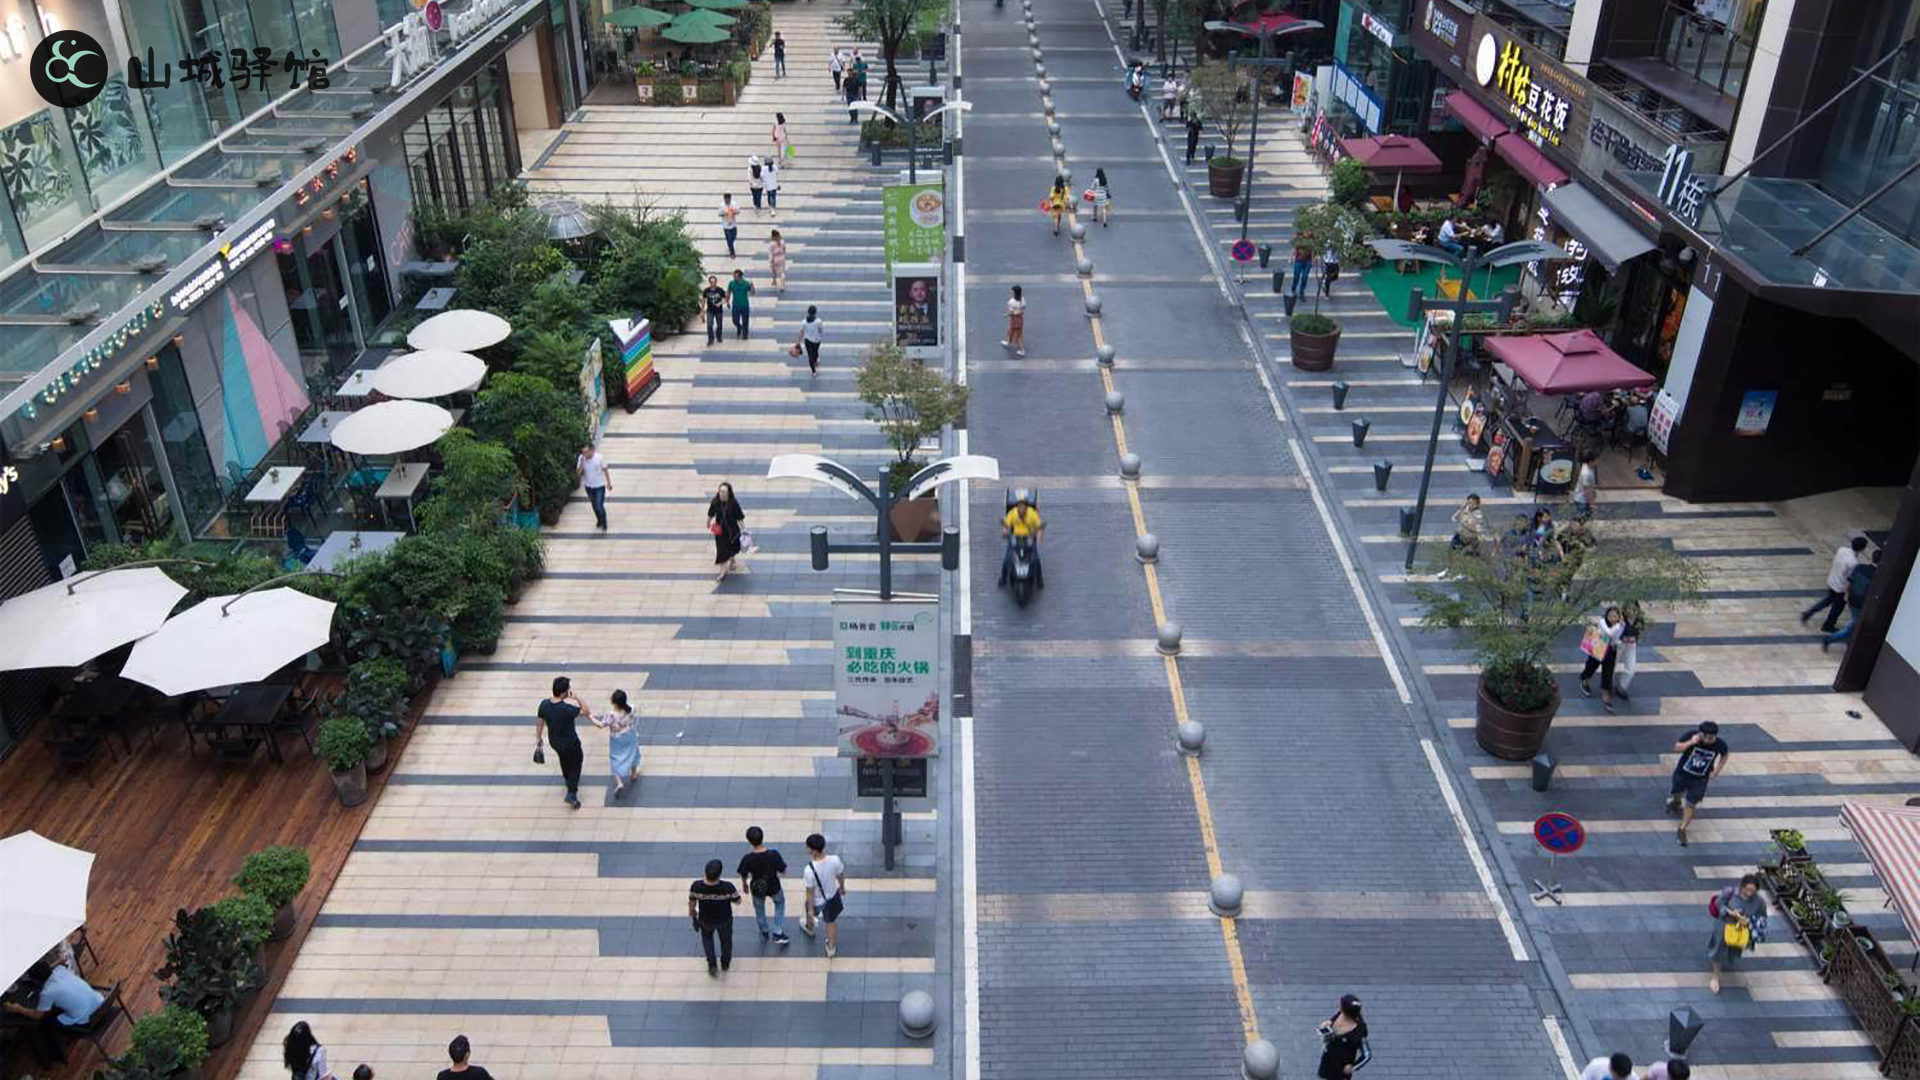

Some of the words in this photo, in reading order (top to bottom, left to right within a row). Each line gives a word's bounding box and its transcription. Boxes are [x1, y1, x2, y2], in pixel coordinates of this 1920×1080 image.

[846, 646, 897, 659] 到重庆
[847, 661, 930, 674] 必吃的火锅
